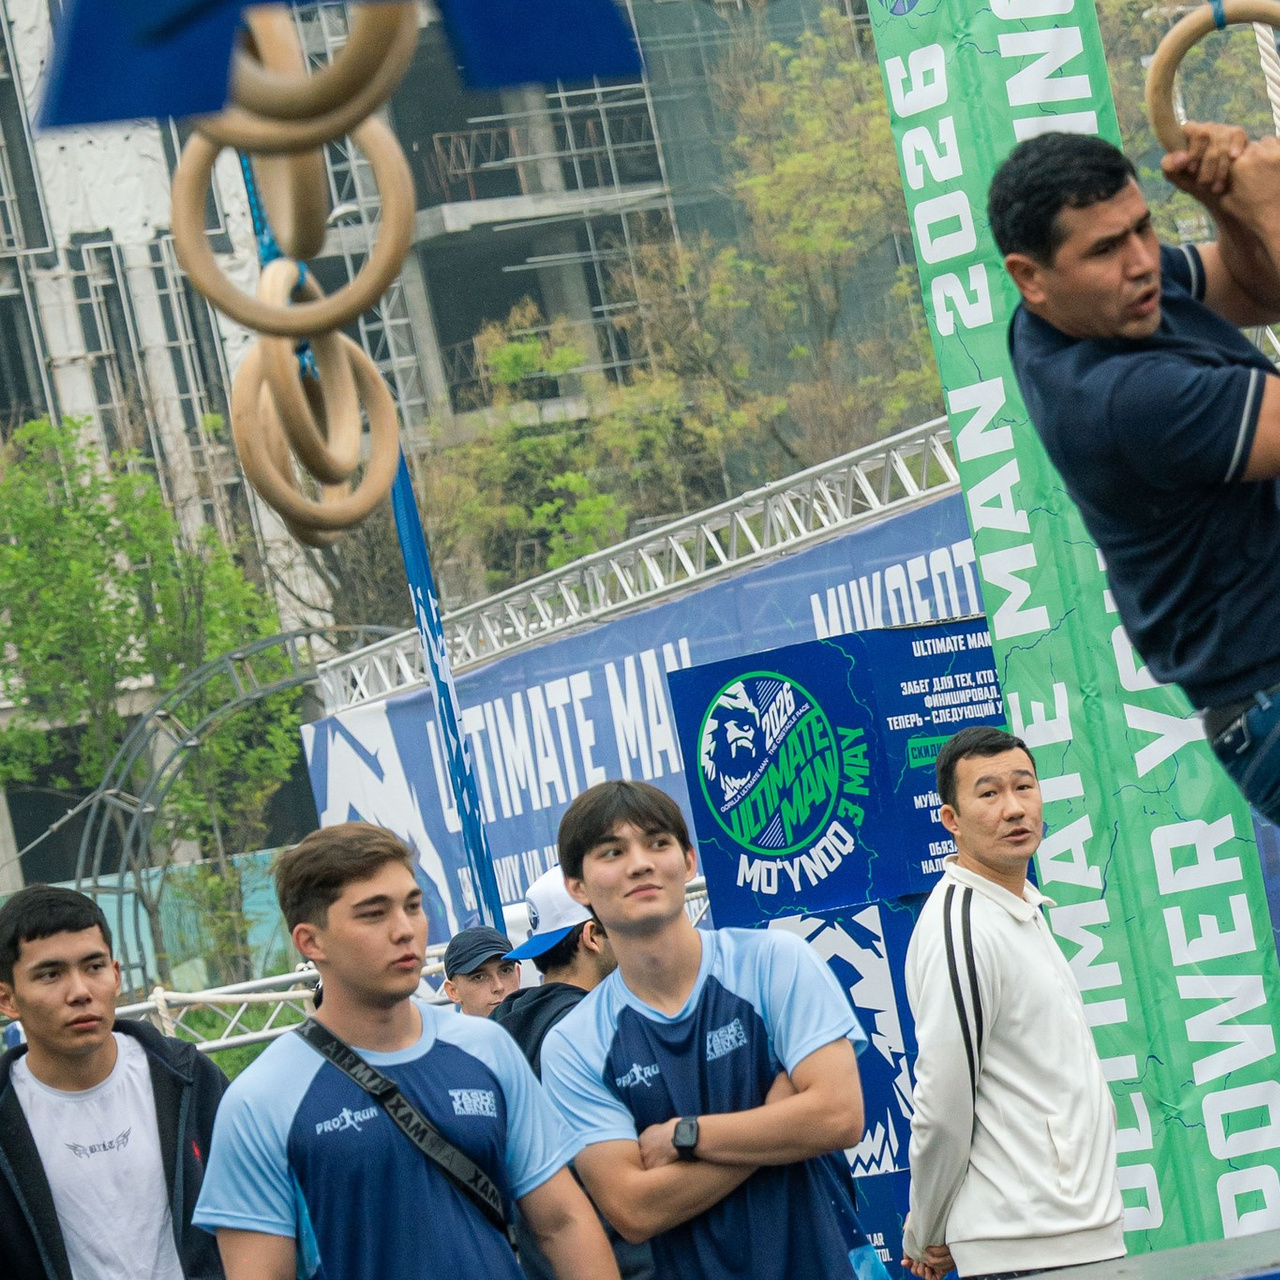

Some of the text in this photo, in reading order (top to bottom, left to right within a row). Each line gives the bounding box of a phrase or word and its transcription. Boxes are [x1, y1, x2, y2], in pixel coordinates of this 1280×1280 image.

[885, 43, 993, 336] 2026
[947, 376, 1050, 640] MAN
[912, 631, 992, 657] ULTIMATE MAN
[761, 681, 796, 751] 2026
[887, 713, 923, 731] ТЕПЕРЬ
[931, 699, 996, 725] СЛЕДУЮЩИЙ
[900, 679, 930, 696] ЗАБЕГ
[932, 677, 954, 693] ДЛЯ
[953, 672, 976, 688] ТЕХ,
[975, 669, 995, 685] КТО
[924, 685, 1001, 708] ФИНИШИРОВАЛ.
[729, 715, 831, 843] ULTIMATE
[836, 725, 870, 796] MAY
[780, 750, 839, 846] MAN
[836, 797, 866, 827] 3
